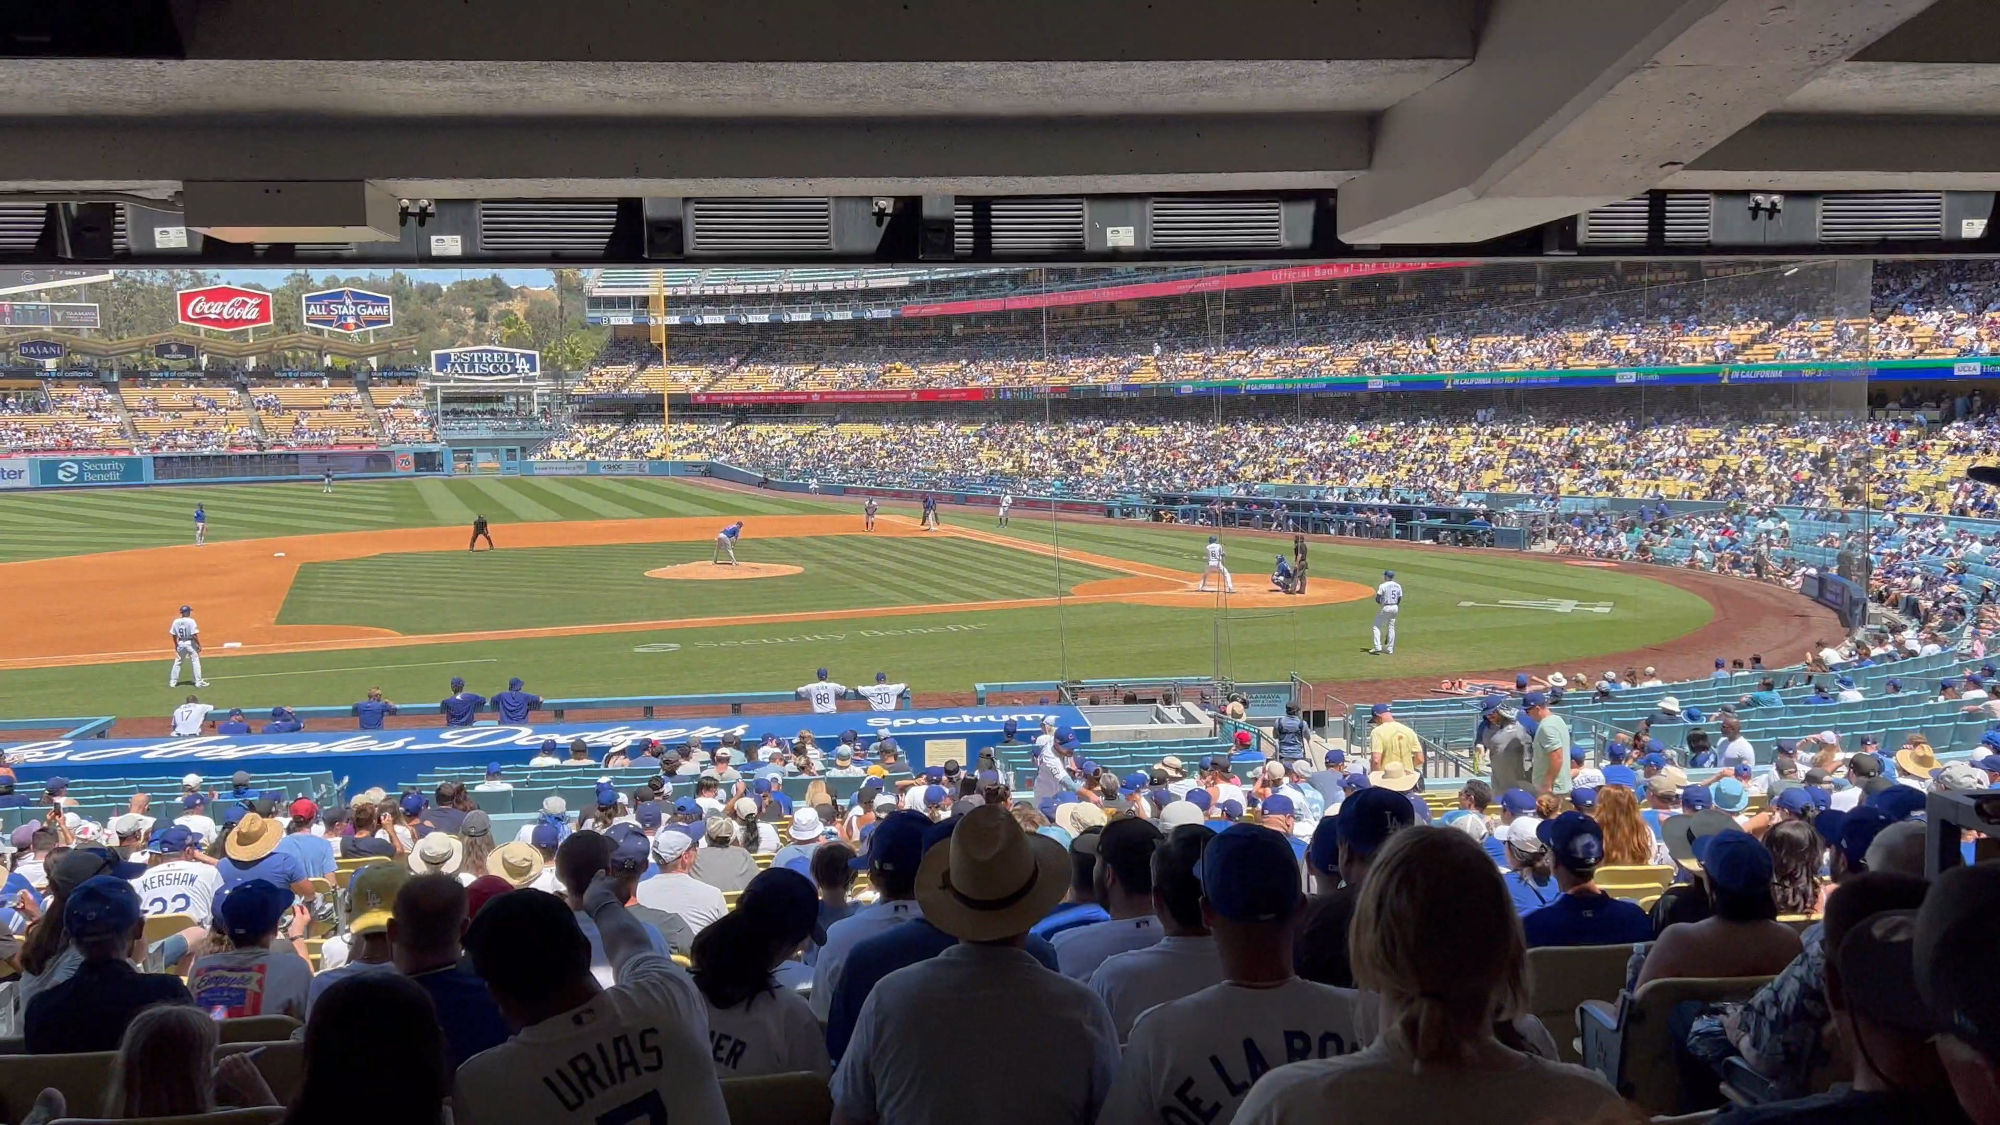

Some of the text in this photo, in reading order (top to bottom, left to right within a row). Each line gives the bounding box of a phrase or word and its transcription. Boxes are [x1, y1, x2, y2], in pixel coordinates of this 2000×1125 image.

[1272, 268, 1310, 281] Official
[1315, 265, 1338, 277] Bank
[1344, 264, 1354, 276] of
[1359, 262, 1377, 273] the
[187, 296, 263, 320] Coca-Cola
[309, 304, 389, 316] ALL STAR GAME
[22, 345, 61, 355] DASANI
[443, 363, 511, 374] JALISCO
[82, 461, 126, 472] Security
[399, 457, 412, 468] 76
[84, 472, 121, 481] Benefit
[1391, 590, 1397, 600] 5
[178, 627, 187, 638] 91
[694, 623, 988, 648] Security Benefit
[816, 693, 830, 704] 88
[876, 692, 890, 705] 30
[181, 710, 193, 721] 17
[866, 713, 1050, 728] Spectrum
[67, 735, 416, 761] Angeles
[405, 725, 750, 751] Dodgers
[142, 872, 199, 893] KERSHAW
[149, 893, 191, 915] 22
[543, 1027, 664, 1112] URIAS
